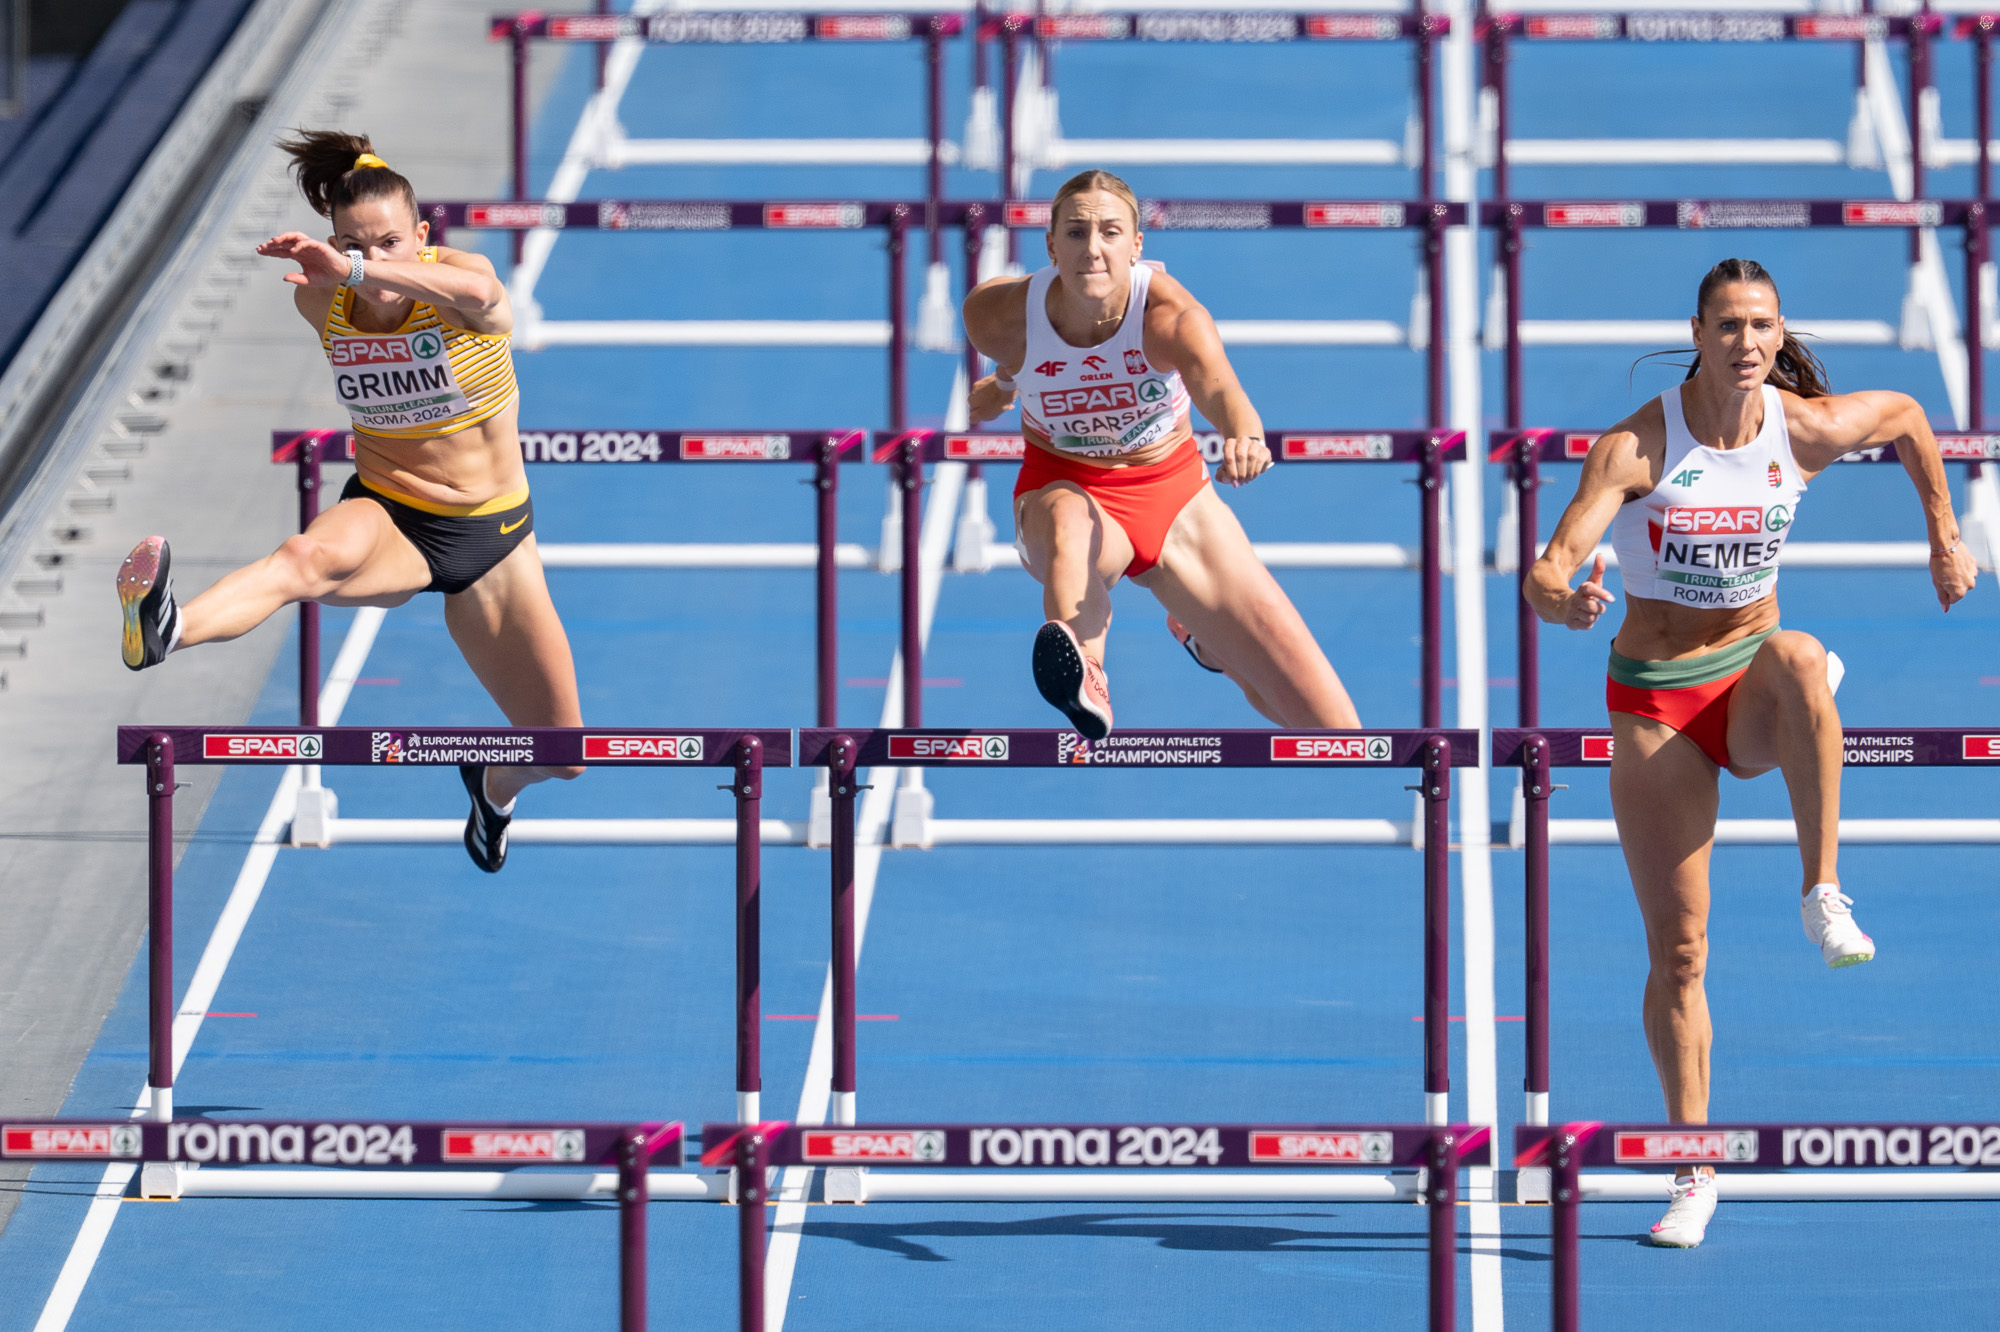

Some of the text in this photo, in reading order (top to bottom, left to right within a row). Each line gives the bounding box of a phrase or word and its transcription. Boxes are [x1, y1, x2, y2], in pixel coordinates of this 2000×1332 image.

[332, 341, 410, 363] SPAR
[1034, 361, 1068, 377] 4F
[1080, 372, 1113, 382] ORLEN
[337, 364, 449, 400] GRIMM
[1043, 386, 1135, 414] SPAR
[363, 405, 456, 425] ROMA 2024
[369, 405, 394, 414] RUN
[518, 432, 663, 462] ma 2024
[703, 439, 764, 456] SPAR
[969, 439, 1026, 456] SPAR
[1087, 436, 1113, 446] RUN
[1304, 440, 1366, 456] SPAR
[1939, 439, 1982, 456] PAR
[1671, 470, 1704, 487] 4F
[1670, 510, 1760, 532] SPAR
[1664, 539, 1781, 569] NEMES
[1685, 573, 1755, 587] I RUN CLEAN
[1674, 584, 1762, 603] ROMA 2024
[228, 738, 296, 755] SPAR
[372, 732, 381, 763] roma
[422, 736, 534, 746] EUROPEAN ATHLETICS
[607, 739, 676, 756] SPAR
[913, 739, 982, 756] SPAR
[1058, 733, 1067, 763] roma
[1109, 737, 1222, 746] EUROPEAN ATHLETICS
[1296, 740, 1365, 757] SPAR
[1859, 737, 1914, 746] ATHLETICS
[406, 749, 534, 763] CHAMPIONSHIPS
[1095, 750, 1222, 763] CHAMPIONSHIPS
[1843, 749, 1914, 763] IONSHIPS
[31, 1129, 109, 1151] SPAR
[167, 1123, 417, 1163] roma 2024
[471, 1133, 552, 1156] SPAR
[832, 1133, 912, 1156] SPAR
[970, 1127, 1224, 1165] roma 2024
[1278, 1136, 1359, 1158] SPAR
[1643, 1136, 1723, 1158] SPAR
[1783, 1128, 1921, 1165] roma
